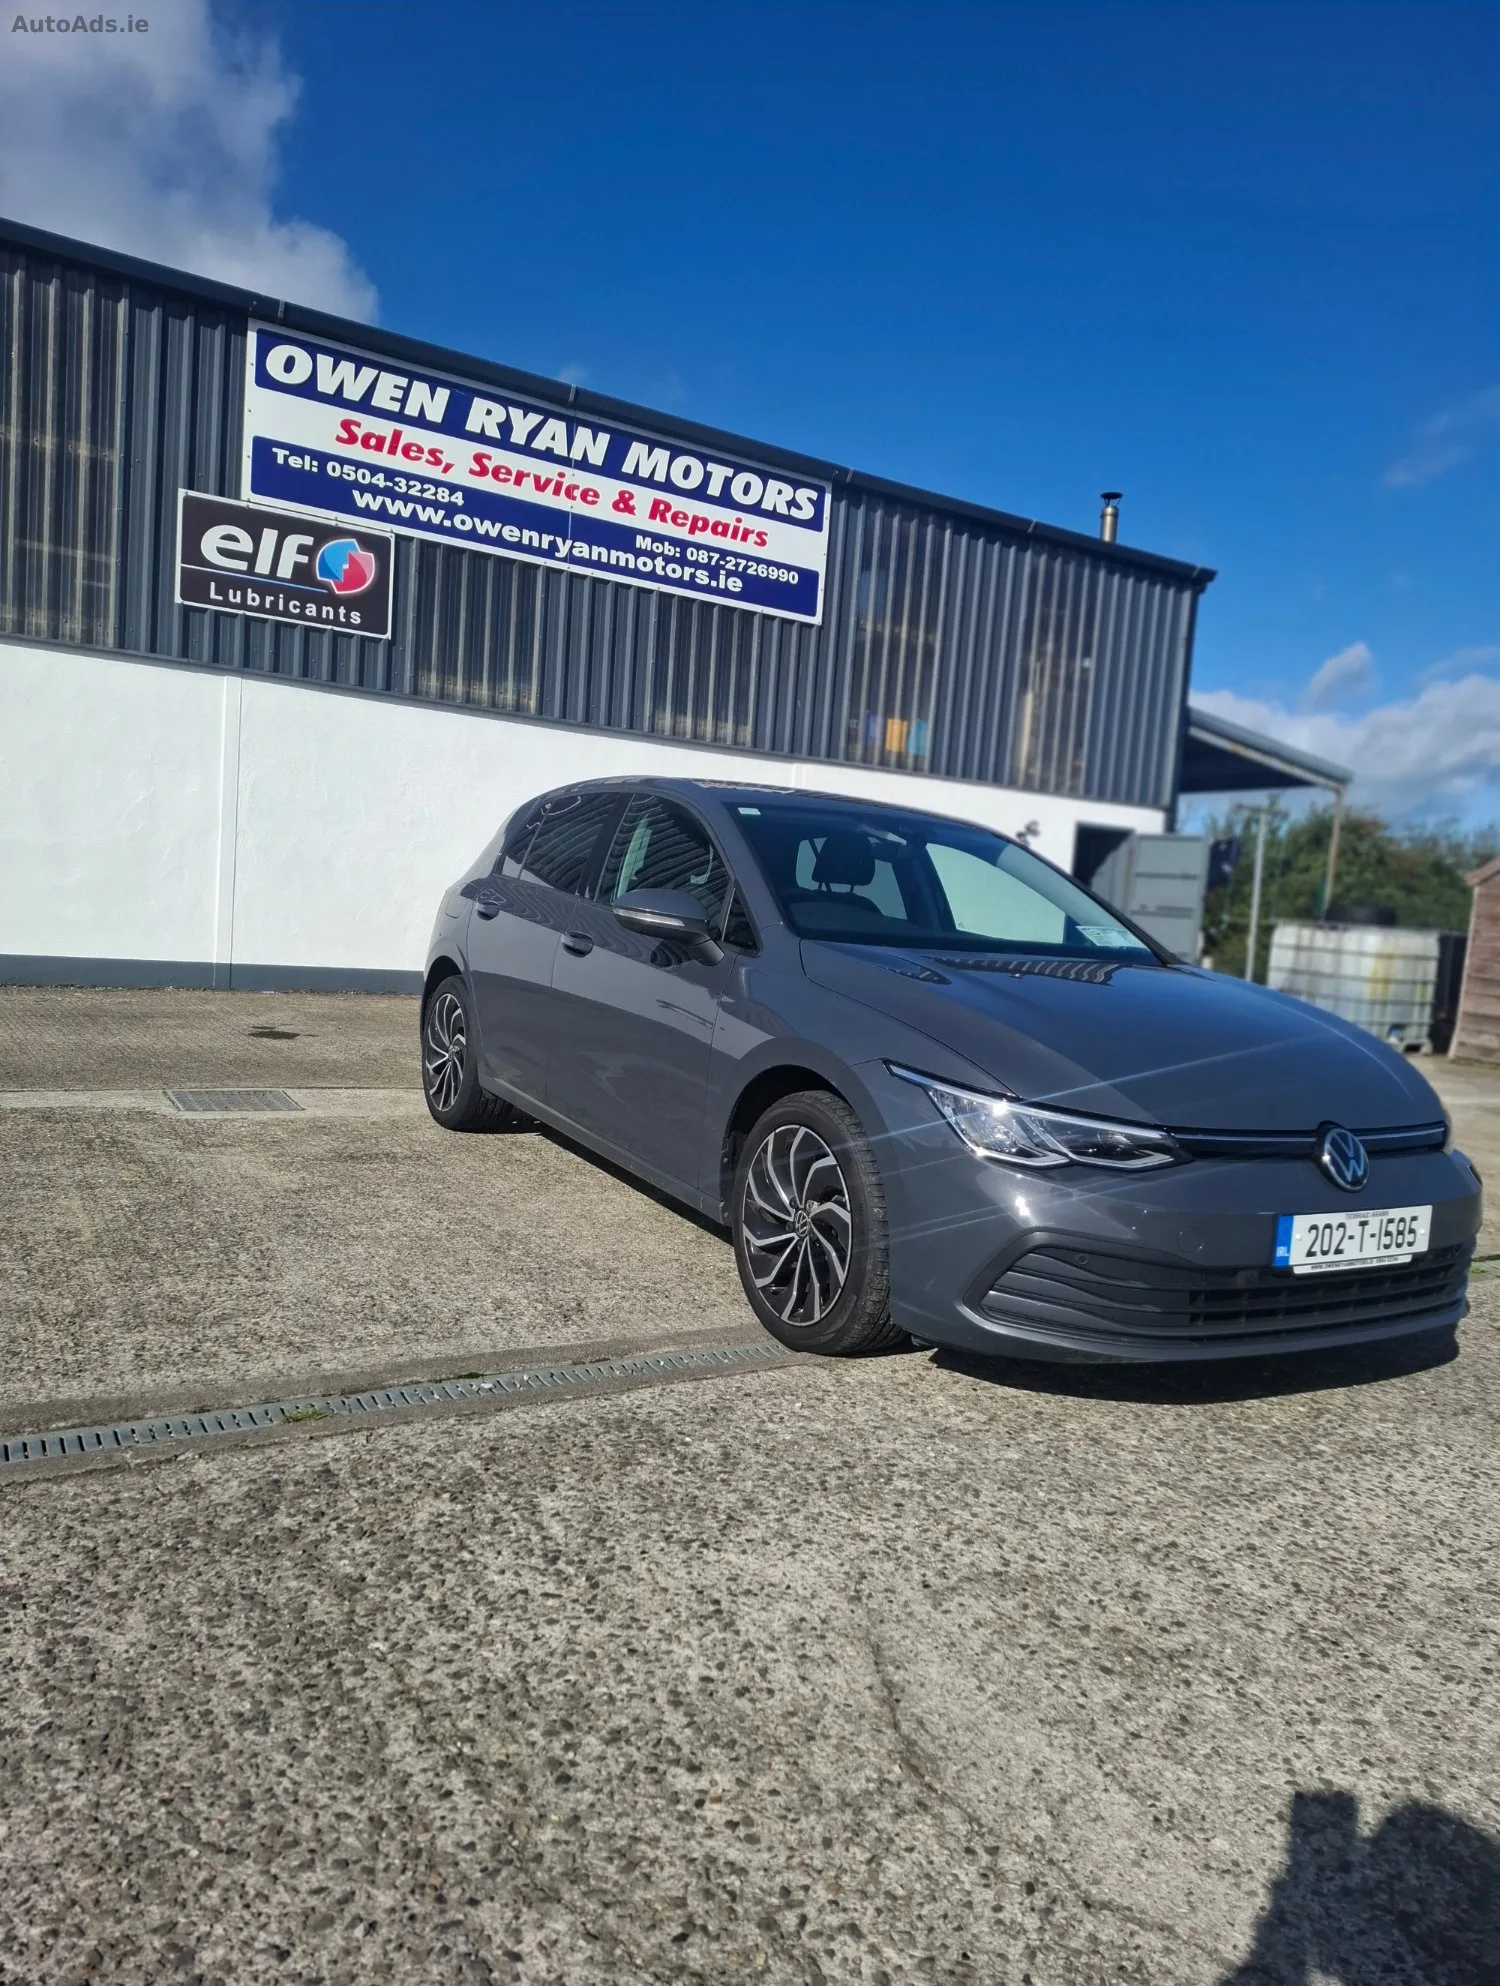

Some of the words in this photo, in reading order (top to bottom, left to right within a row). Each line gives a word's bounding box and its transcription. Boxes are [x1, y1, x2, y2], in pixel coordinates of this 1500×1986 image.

[265, 344, 450, 424] OWEN
[465, 397, 610, 467] RYAN
[621, 441, 818, 521] MOTORS
[272, 447, 318, 473] Tel:
[326, 461, 464, 506] 0504-32284
[335, 418, 455, 475] Sales,
[468, 451, 601, 506] Service
[611, 489, 637, 516] &
[648, 498, 769, 548] Repairs
[200, 524, 314, 580] elf
[352, 489, 743, 593] www.owenryanmotors.ie
[635, 534, 681, 557] Mob:
[686, 547, 799, 585] 087-2726990
[209, 581, 362, 625] Lubricants
[1305, 1215, 1419, 1258] 202-T-1585
